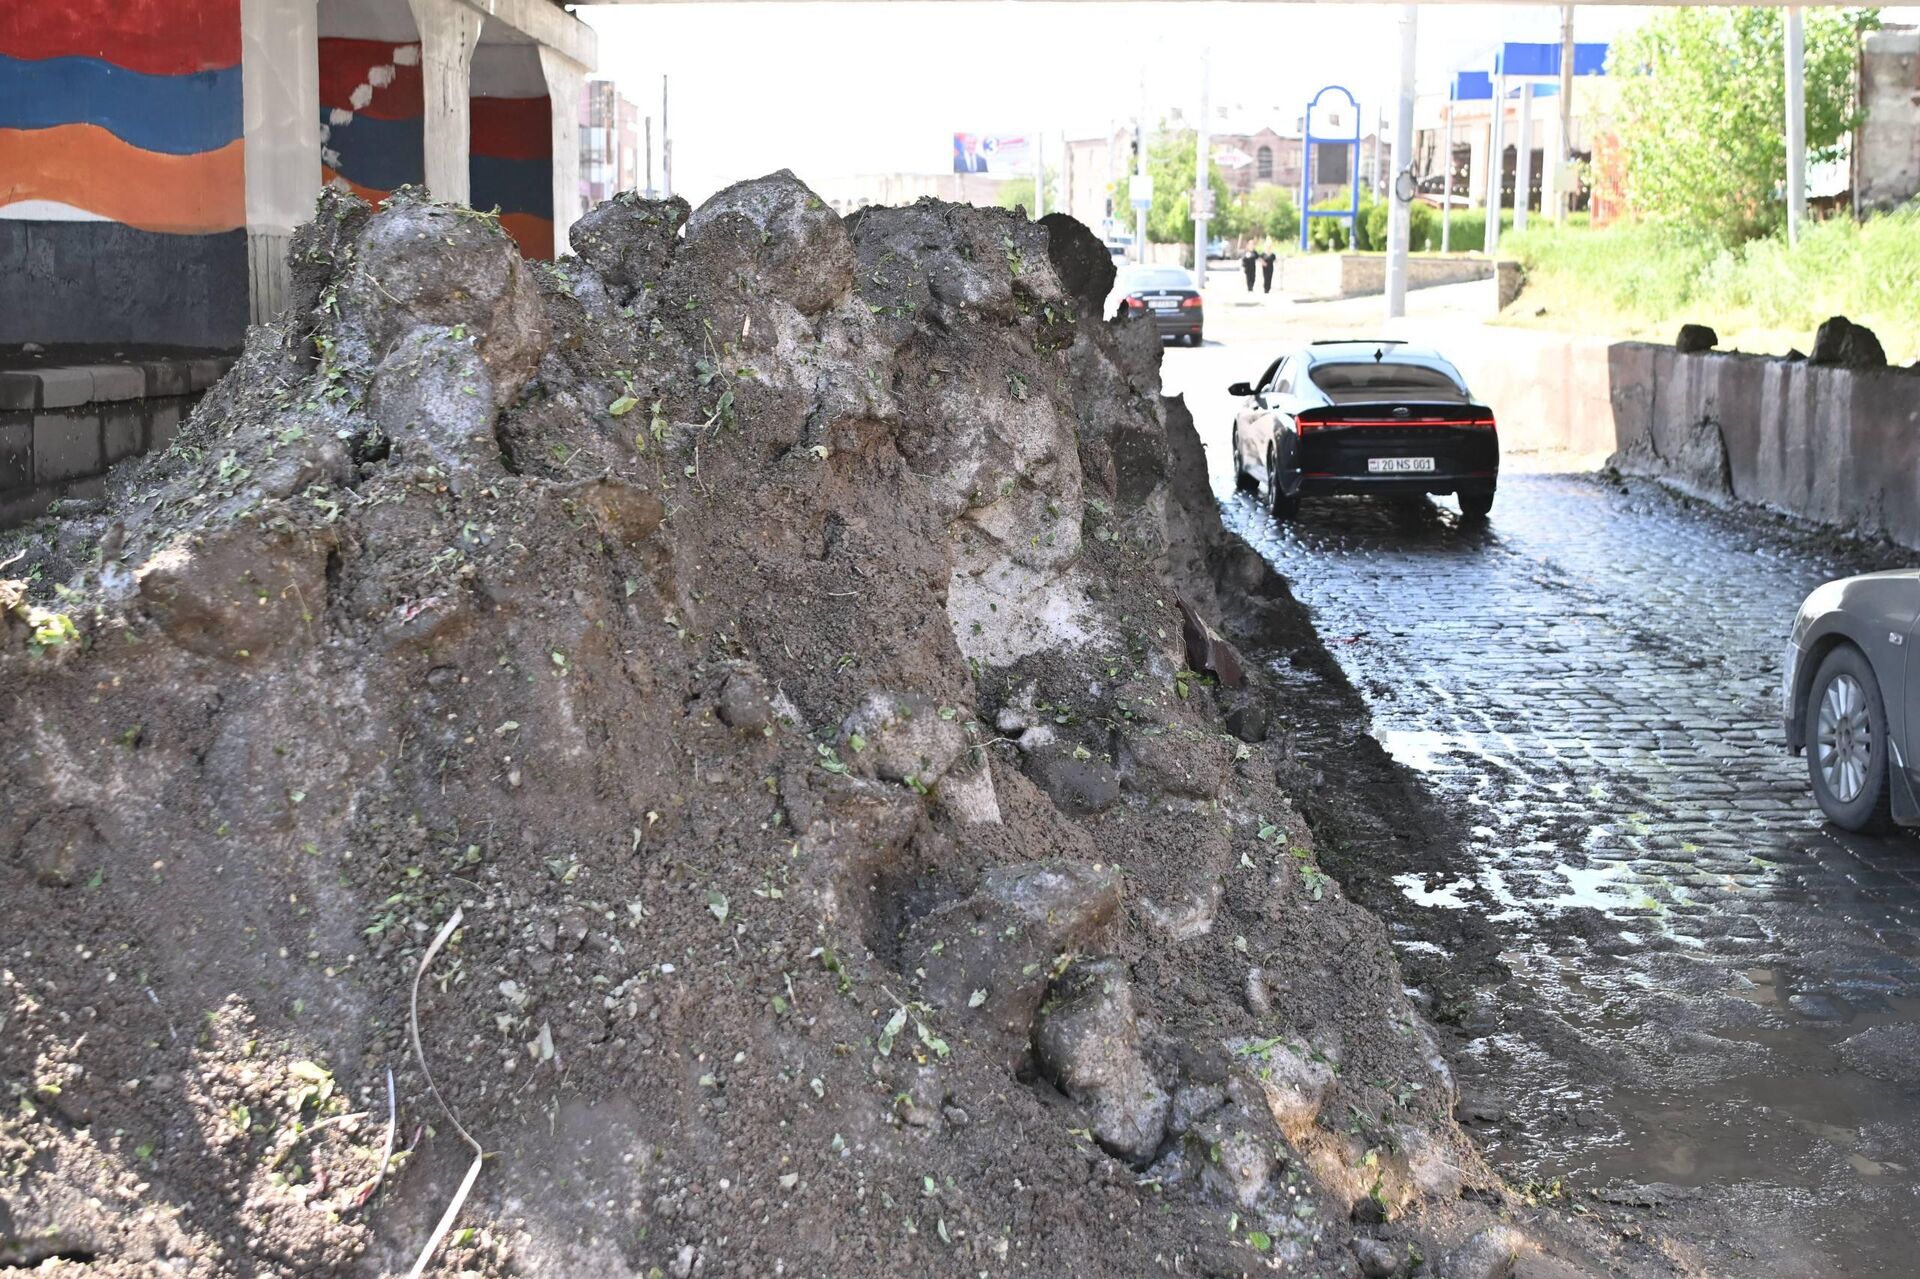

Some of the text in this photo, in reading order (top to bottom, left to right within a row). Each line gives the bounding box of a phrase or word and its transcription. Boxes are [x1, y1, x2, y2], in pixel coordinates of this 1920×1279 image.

[1382, 460, 1394, 470] 20
[1396, 460, 1411, 470] NS
[1413, 459, 1431, 469] 001
